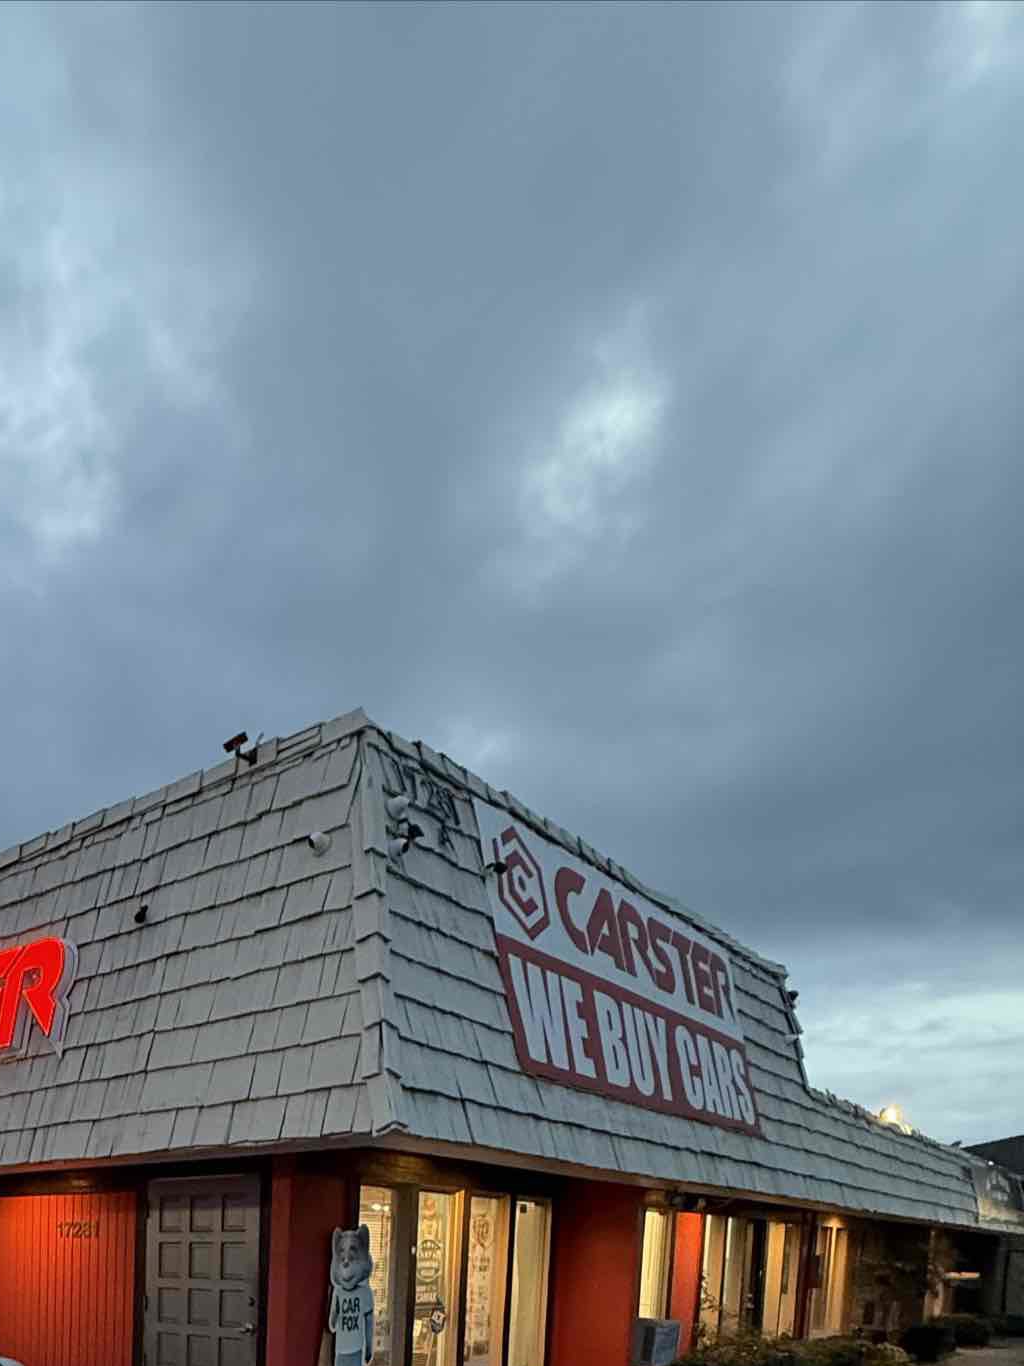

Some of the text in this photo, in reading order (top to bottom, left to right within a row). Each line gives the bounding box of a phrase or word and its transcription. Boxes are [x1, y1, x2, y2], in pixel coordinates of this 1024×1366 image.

[554, 866, 738, 1031] CARSTER
[508, 953, 756, 1126] WE BUY CARS
[57, 1221, 99, 1238] 17281
[341, 1296, 361, 1315] CAR
[341, 1315, 360, 1331] FOX
